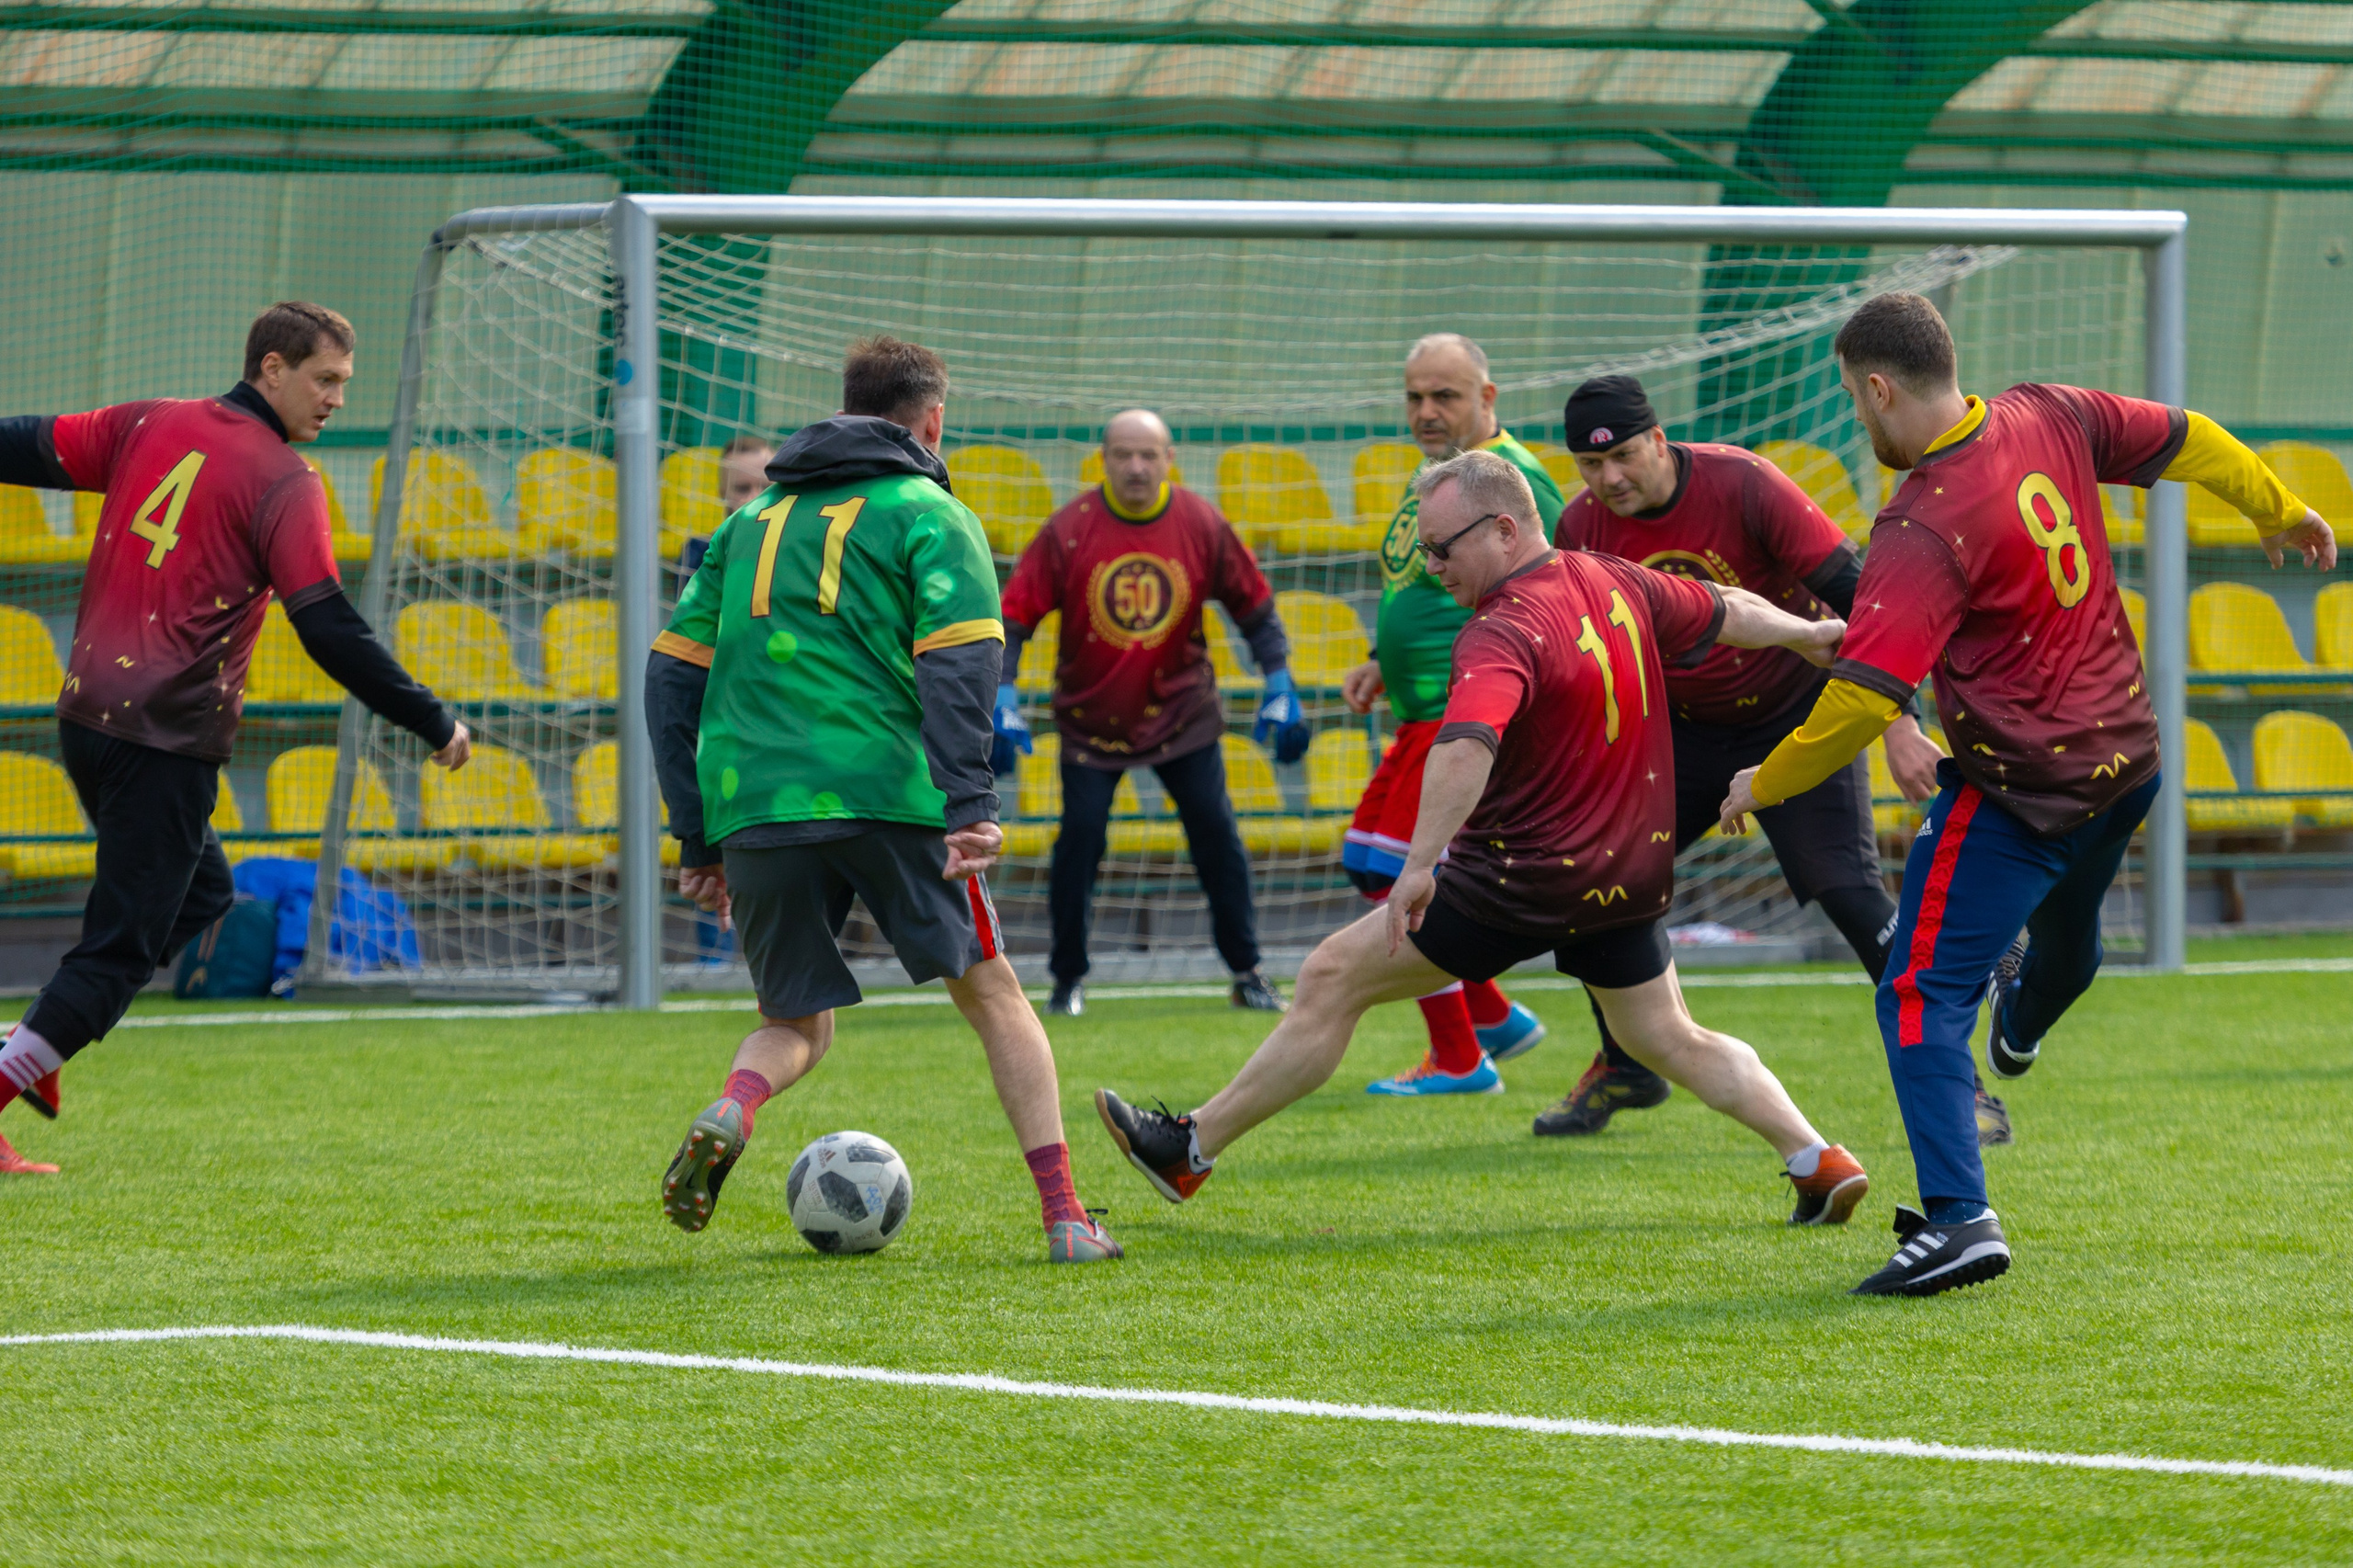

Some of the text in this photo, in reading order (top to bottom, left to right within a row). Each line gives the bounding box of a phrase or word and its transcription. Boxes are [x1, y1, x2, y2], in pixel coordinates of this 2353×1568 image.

[129, 449, 209, 571] 4
[750, 493, 869, 619] 11
[2017, 471, 2090, 609] 8
[1113, 573, 1161, 619] 50
[1575, 587, 1649, 745] 11
